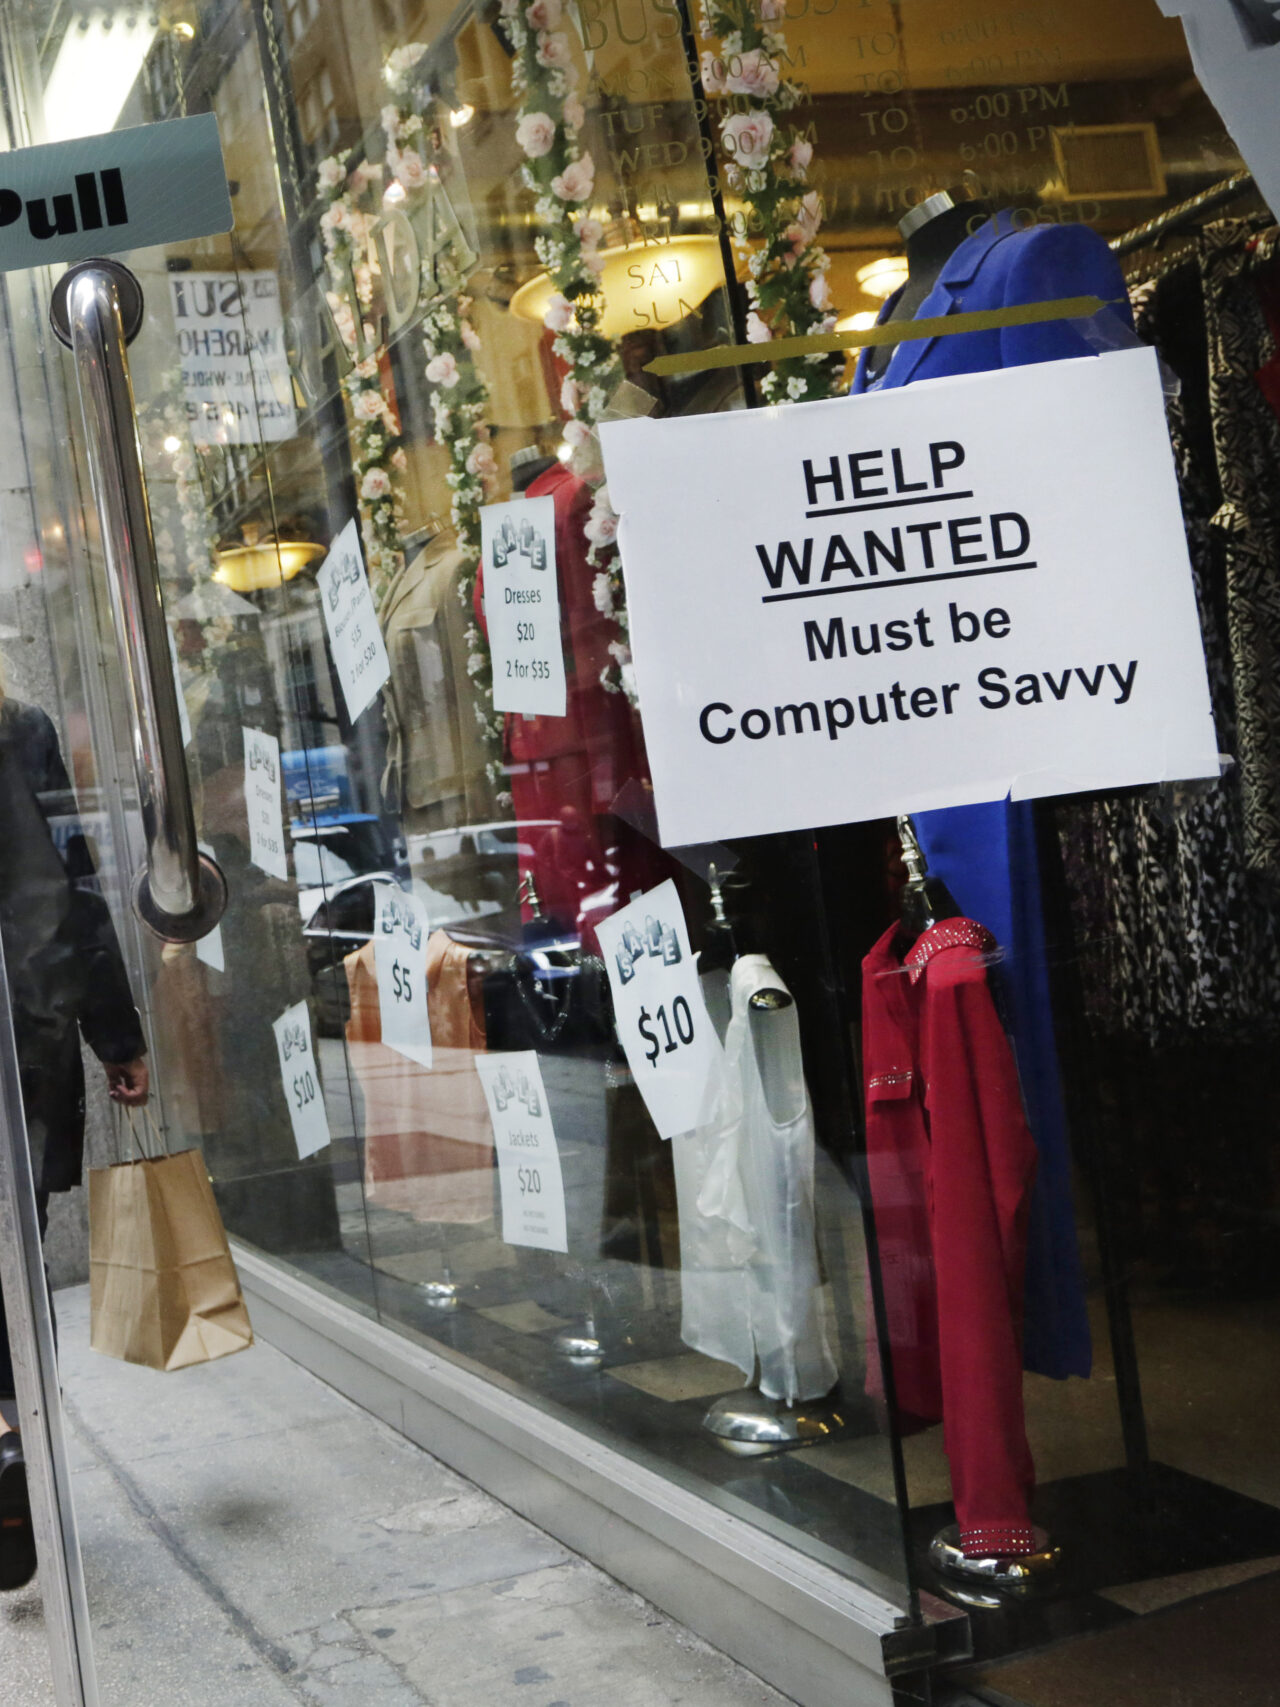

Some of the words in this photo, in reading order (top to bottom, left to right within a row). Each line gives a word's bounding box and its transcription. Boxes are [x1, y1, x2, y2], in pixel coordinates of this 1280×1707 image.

[851, 31, 898, 61] TO
[691, 94, 754, 122] 9:00
[856, 70, 904, 98] TO
[608, 140, 687, 173] WED
[860, 108, 908, 136] TO
[1018, 83, 1070, 113] PM
[960, 131, 1018, 161] 6:00
[627, 260, 682, 289] SAT
[802, 440, 967, 505] HELP
[494, 530, 546, 569] SALE
[755, 511, 1032, 590] WANTED
[505, 588, 541, 604] Dresses
[517, 623, 535, 643] $20
[803, 607, 935, 662] Must
[949, 602, 1012, 643] be
[506, 661, 512, 678] 2
[514, 659, 529, 678] for
[531, 660, 550, 680] $35
[698, 681, 961, 746] Computer
[976, 659, 1140, 711] Savvy
[617, 932, 682, 984] SALE
[391, 958, 413, 1004] $5
[637, 995, 695, 1068] $10
[293, 1070, 316, 1110] $10
[508, 1130, 540, 1149] Jackets
[518, 1168, 542, 1197] $20
